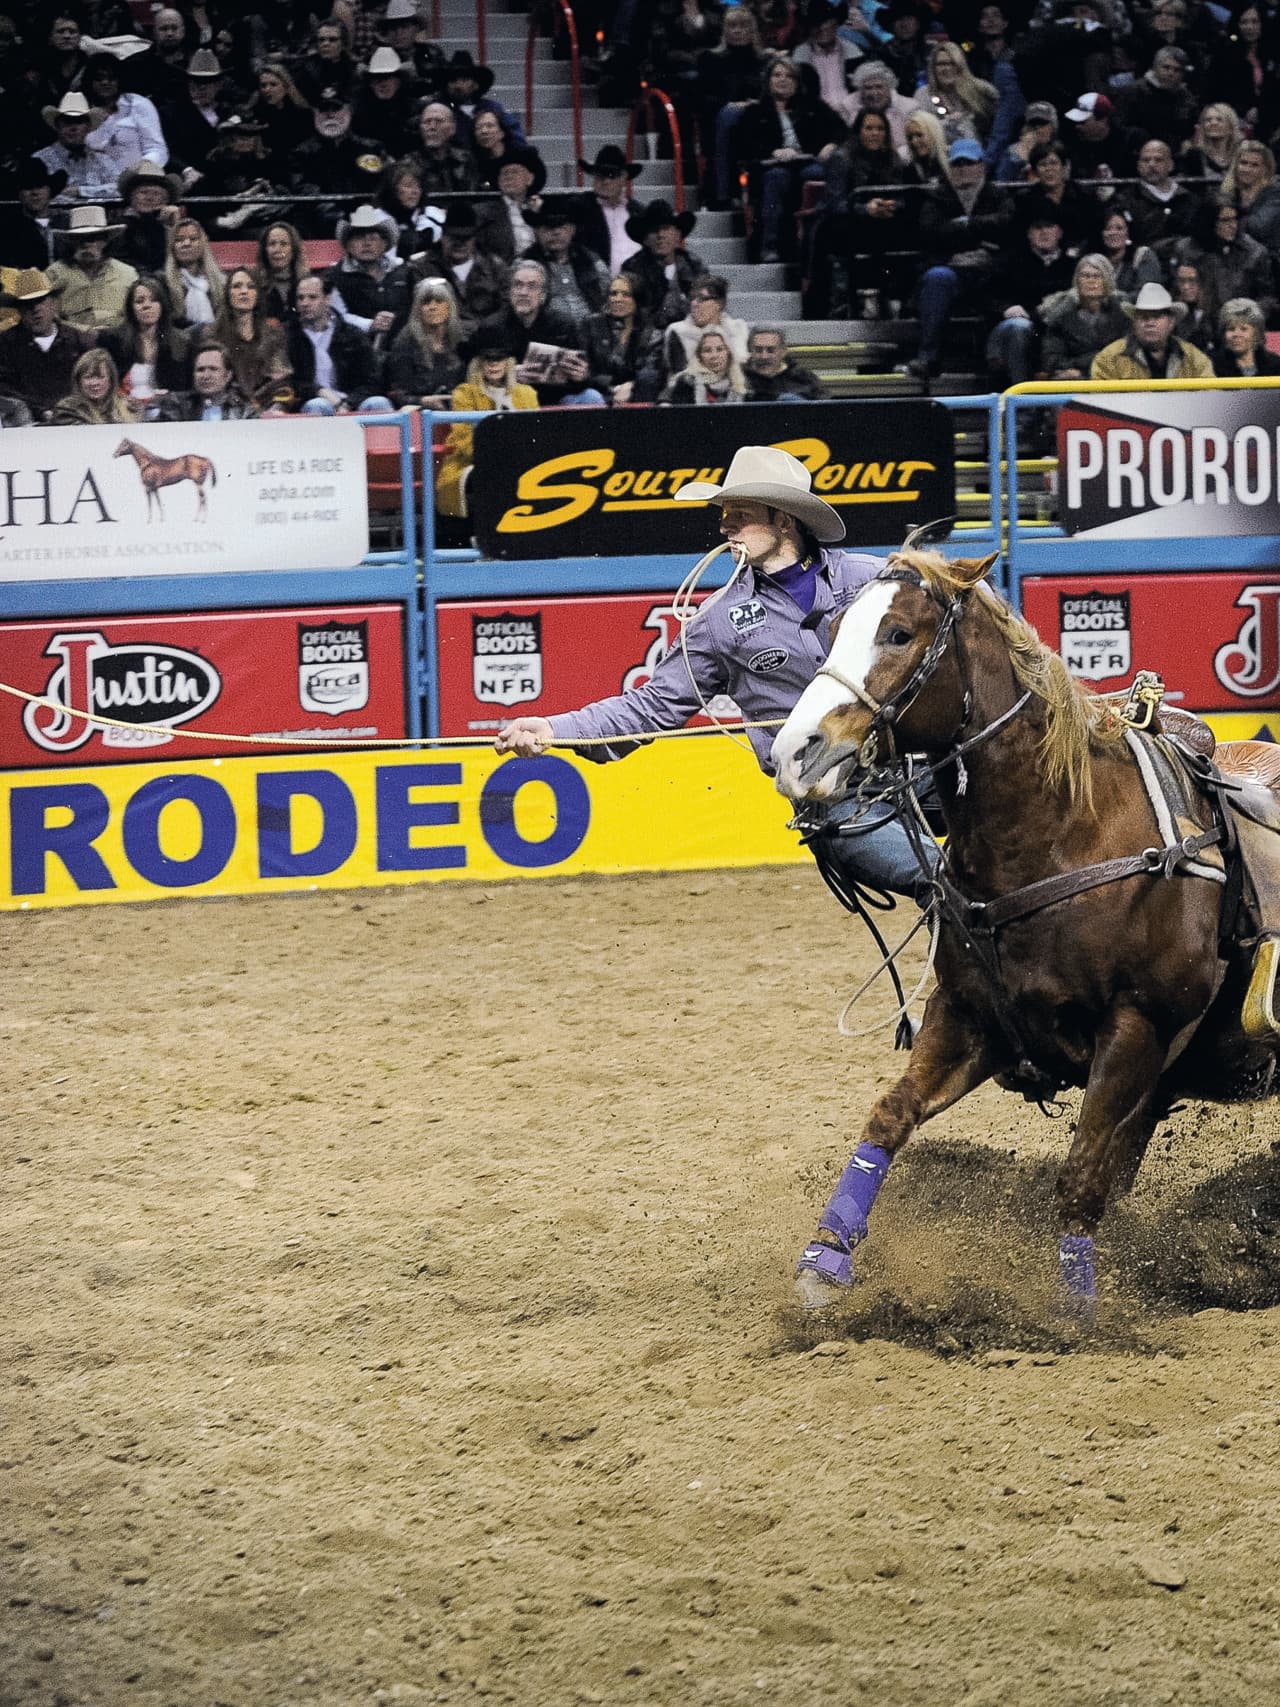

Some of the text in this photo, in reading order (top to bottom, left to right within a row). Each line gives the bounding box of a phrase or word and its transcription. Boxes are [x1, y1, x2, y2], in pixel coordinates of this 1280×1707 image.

[248, 457, 344, 475] LIFE IS A RIDE
[258, 485, 335, 502] aqha.com
[496, 447, 725, 533] SOUTH
[1063, 599, 1124, 613] OFFICIAL
[475, 621, 535, 636] OFFICIAL
[1063, 612, 1126, 630] BOOTS
[301, 630, 362, 645] OFFICIAL
[476, 635, 537, 654] BOOTS
[302, 644, 364, 663] BOOTS
[23, 632, 204, 750] Justin
[9, 755, 592, 896] RODEO
